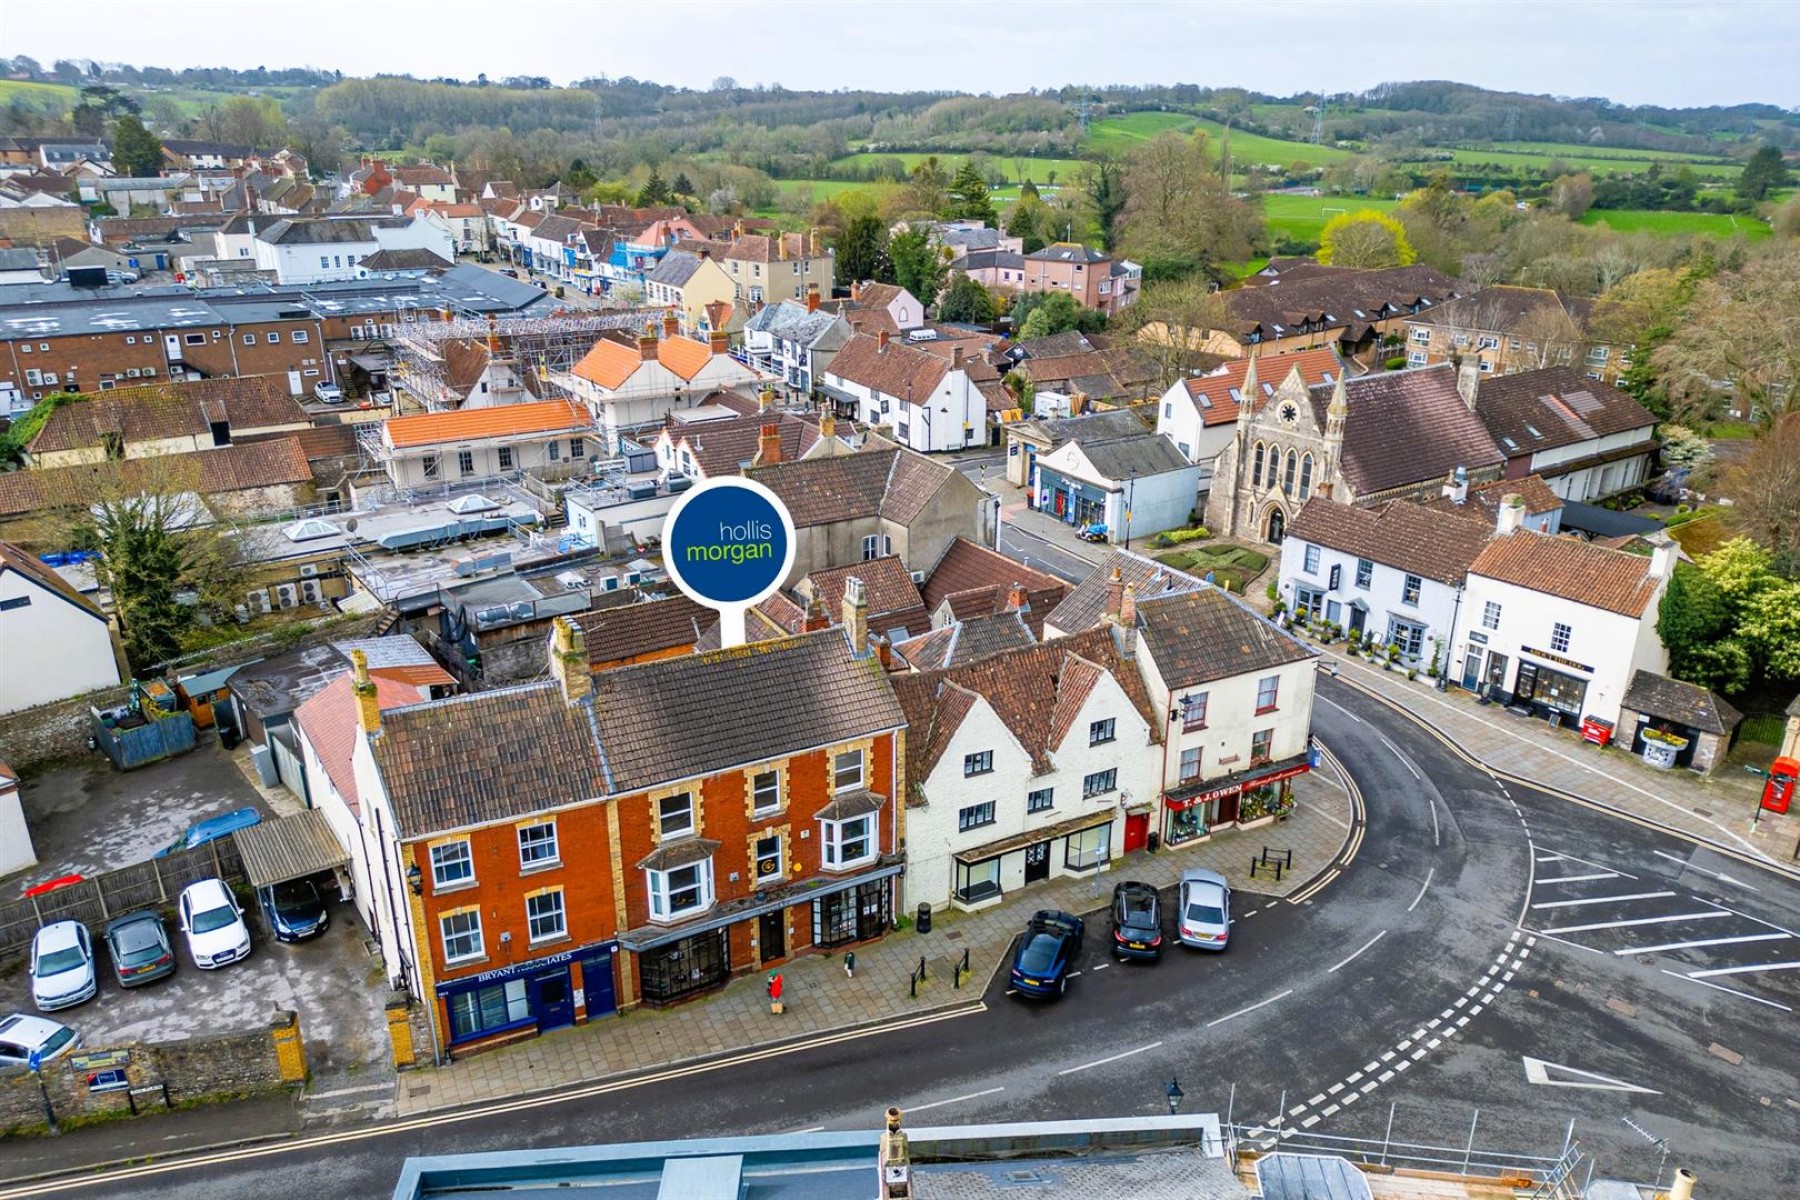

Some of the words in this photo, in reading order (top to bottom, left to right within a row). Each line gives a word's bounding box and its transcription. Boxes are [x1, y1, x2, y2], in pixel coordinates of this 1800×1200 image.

[1193, 795, 1202, 804] &
[1212, 784, 1242, 799] OWEN
[478, 966, 515, 982] BRYANT
[517, 952, 572, 973] IATES
